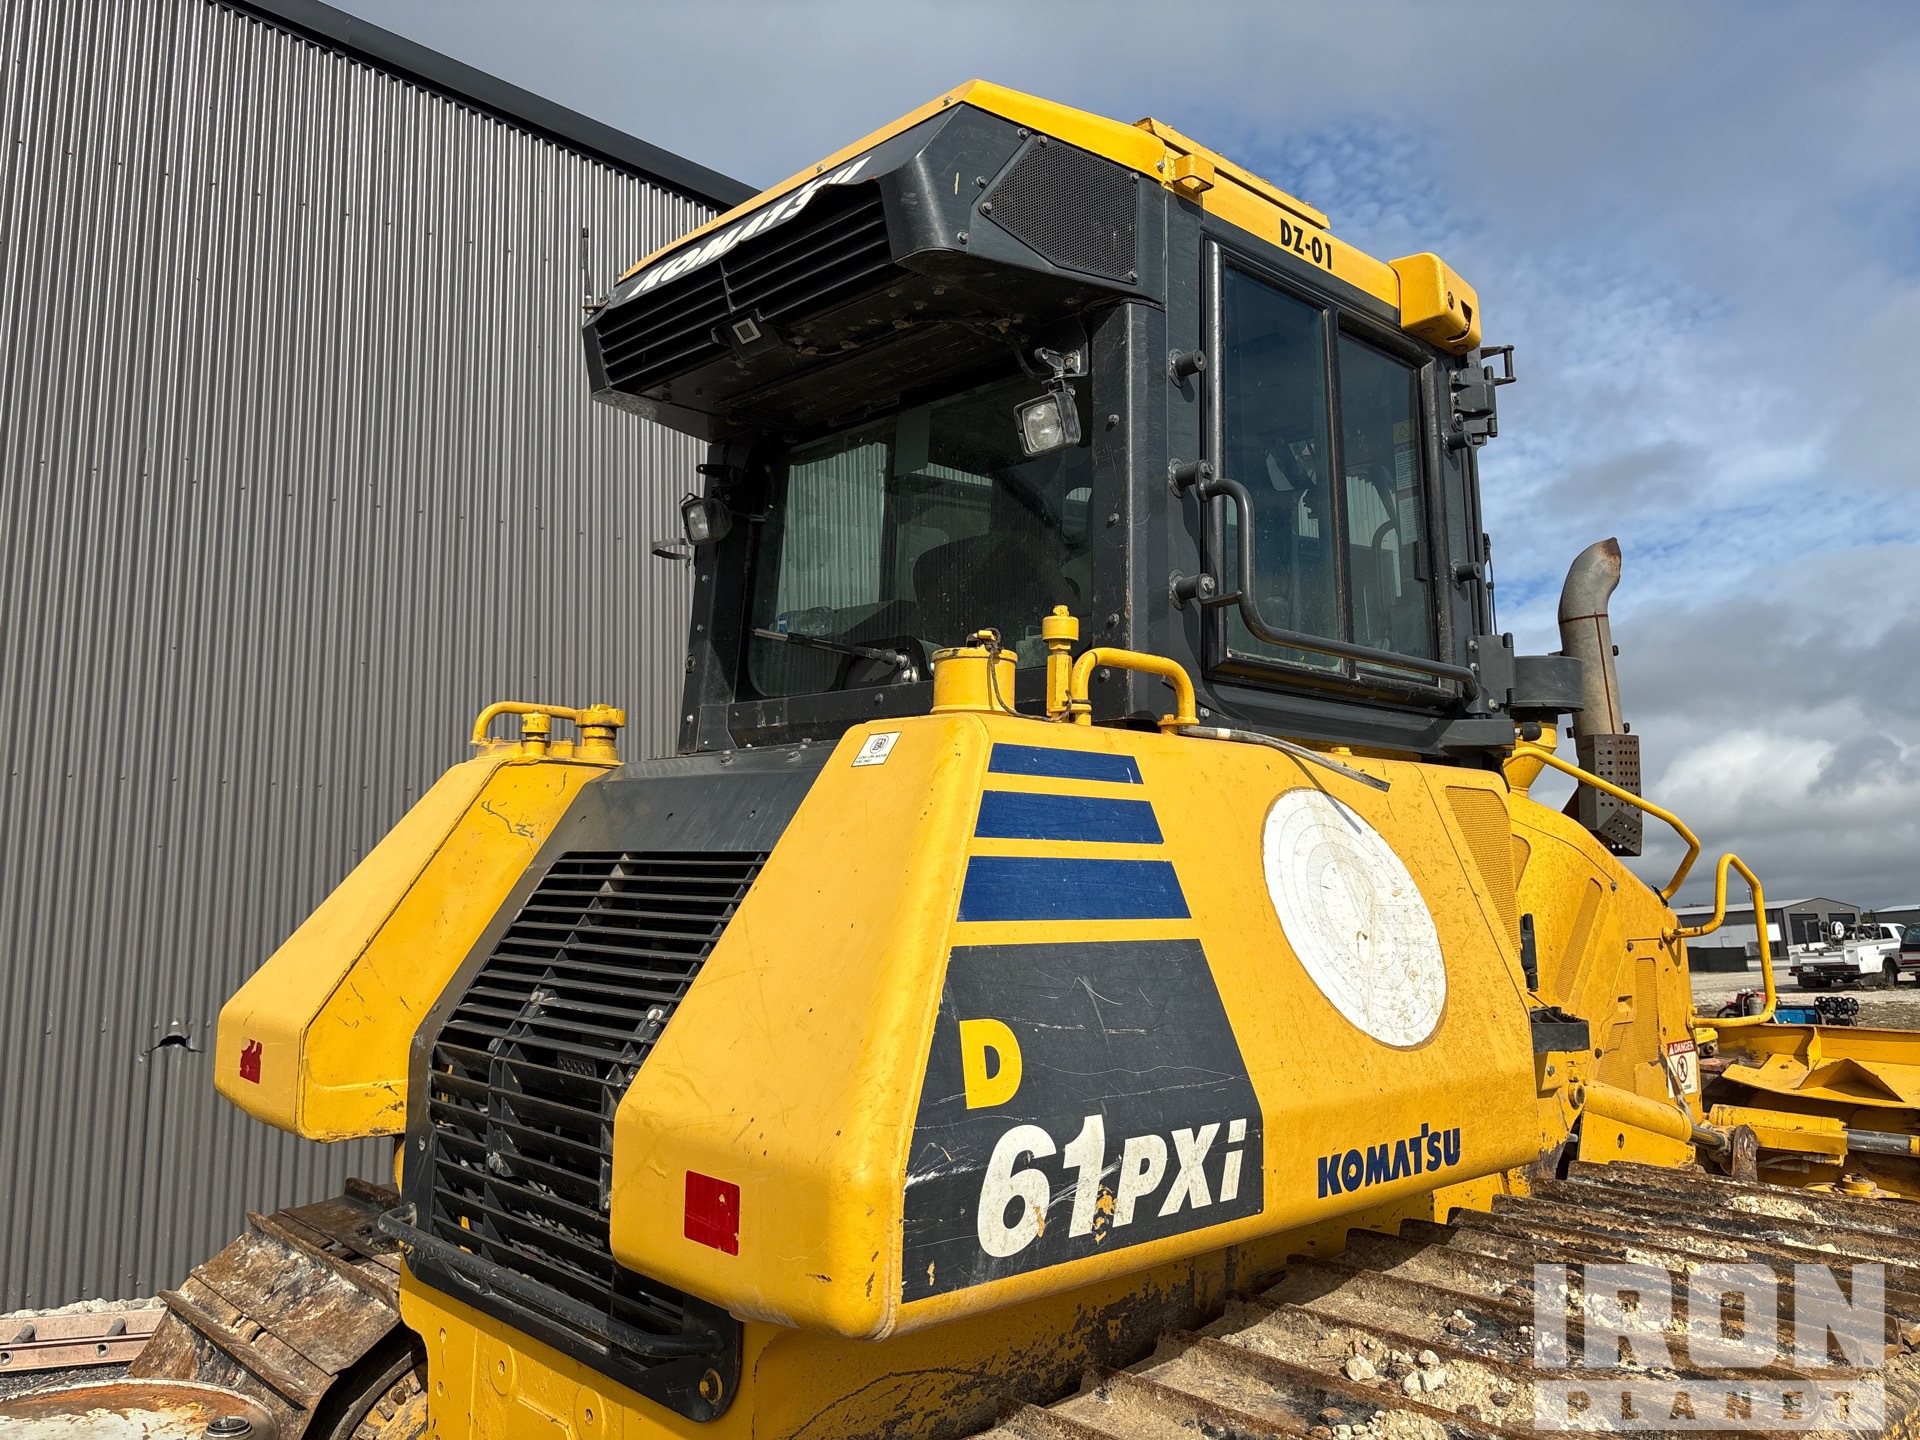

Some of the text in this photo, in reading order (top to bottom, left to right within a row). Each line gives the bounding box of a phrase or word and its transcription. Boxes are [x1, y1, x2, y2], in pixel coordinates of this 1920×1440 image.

[626, 156, 872, 299] KOMATSU
[1280, 218, 1332, 270] DZ-01
[959, 1018, 1023, 1110] D
[1673, 1040, 1695, 1054] DANGER
[1317, 1122, 1461, 1199] KOMATSU
